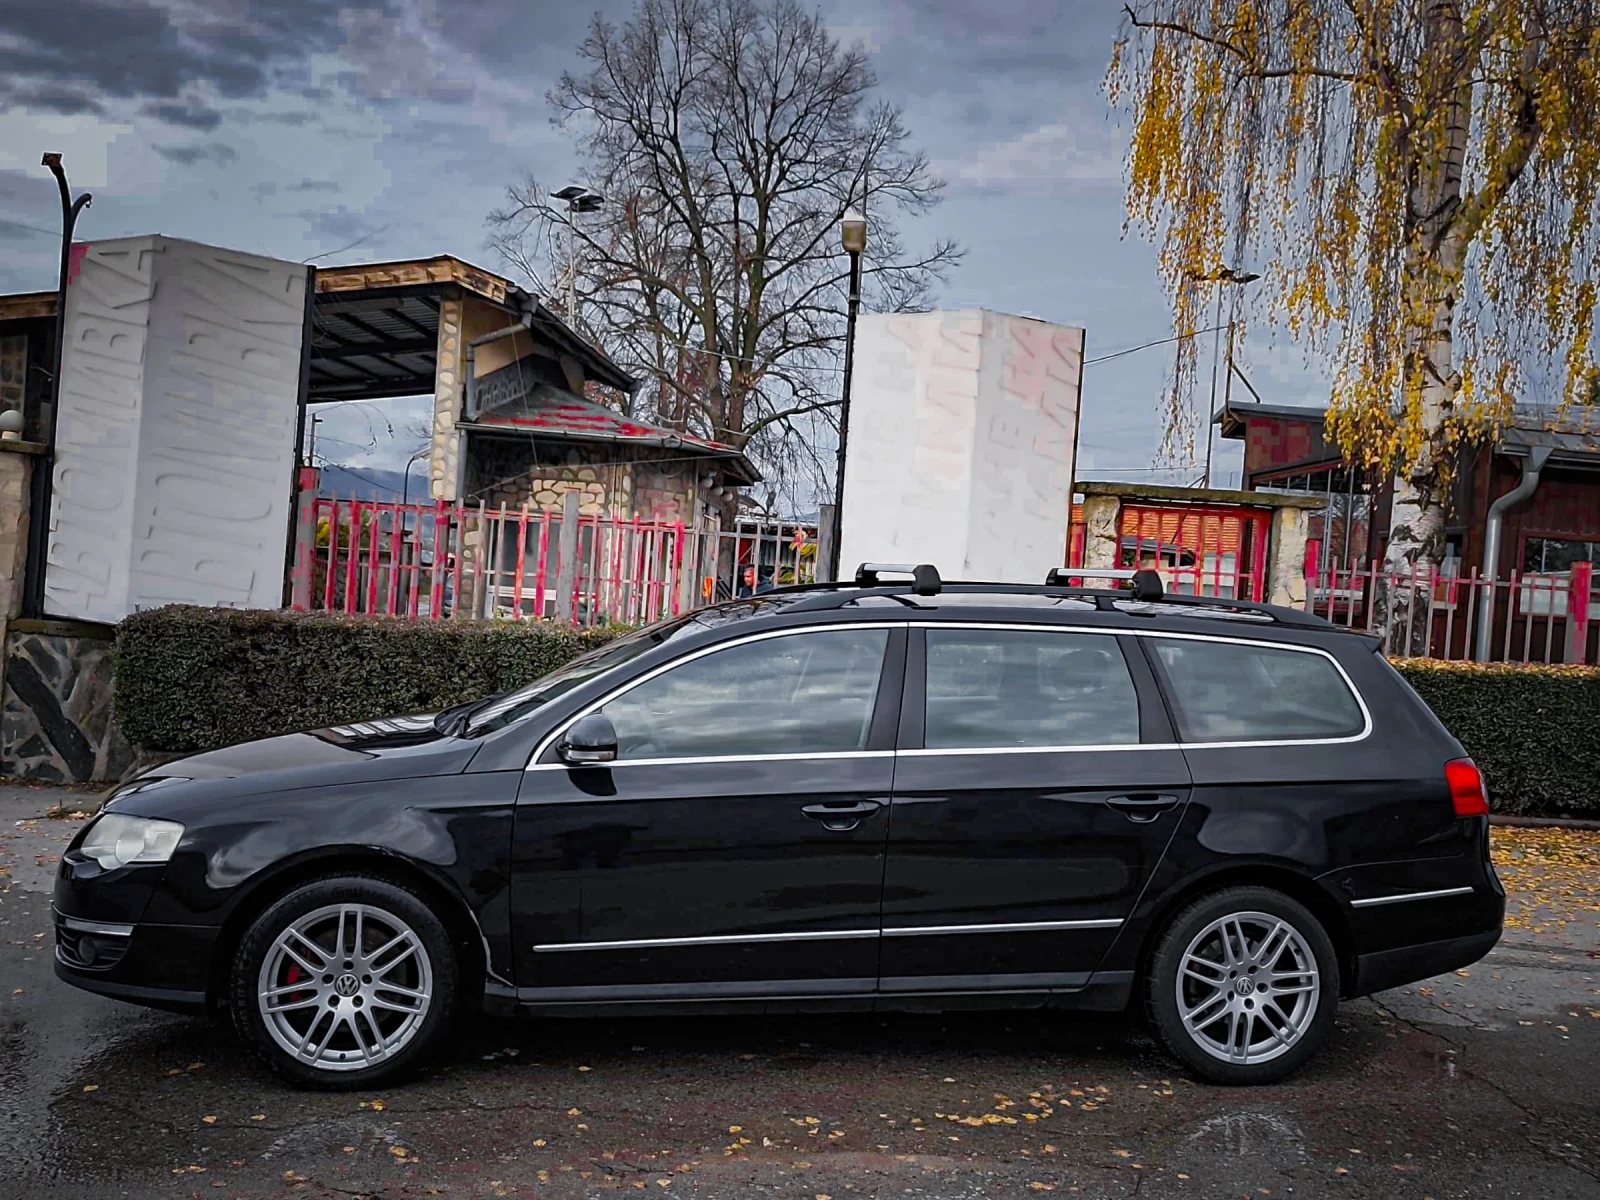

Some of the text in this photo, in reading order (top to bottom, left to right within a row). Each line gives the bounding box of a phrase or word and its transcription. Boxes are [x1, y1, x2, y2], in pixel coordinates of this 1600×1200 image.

[130, 257, 304, 607] ВТОМИВКА
[336, 974, 358, 996] VW
[1236, 977, 1254, 995] VW
